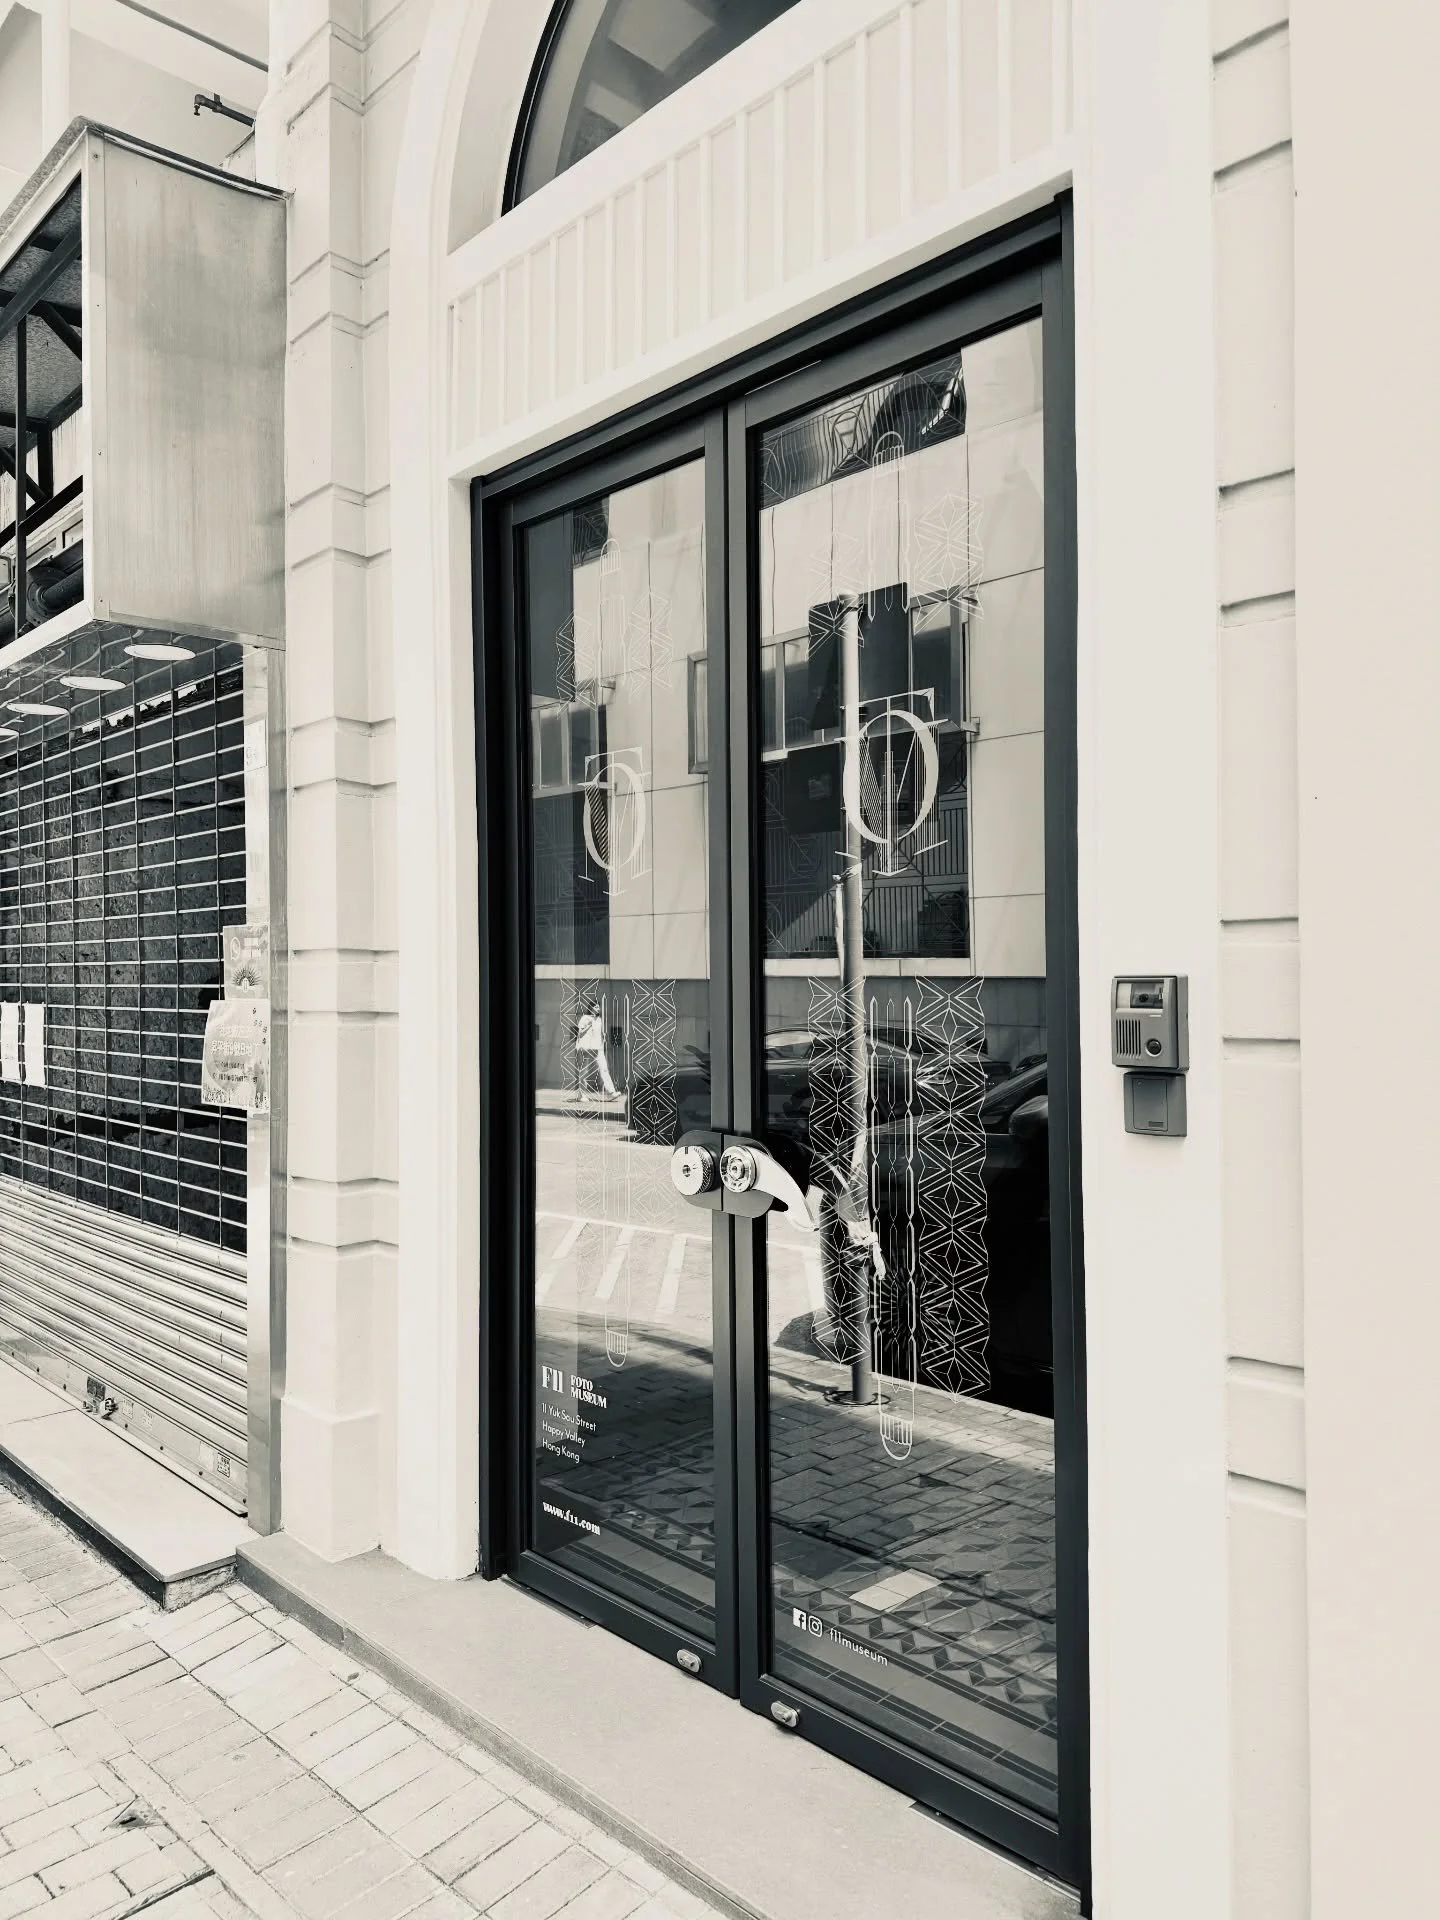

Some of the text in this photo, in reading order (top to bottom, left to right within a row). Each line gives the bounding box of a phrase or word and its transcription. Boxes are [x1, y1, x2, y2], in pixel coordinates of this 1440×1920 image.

[571, 1375, 593, 1392] FOTO
[571, 1388, 607, 1409] MUSEUM
[542, 1402, 547, 1414] 11
[548, 1405, 561, 1419] Yuk
[576, 1414, 597, 1432] Street
[543, 1420, 586, 1448] Happy Valley
[542, 1437, 580, 1464] Hong Kong
[543, 1502, 600, 1536] www.f11.com
[830, 1628, 888, 1666] f11museum
